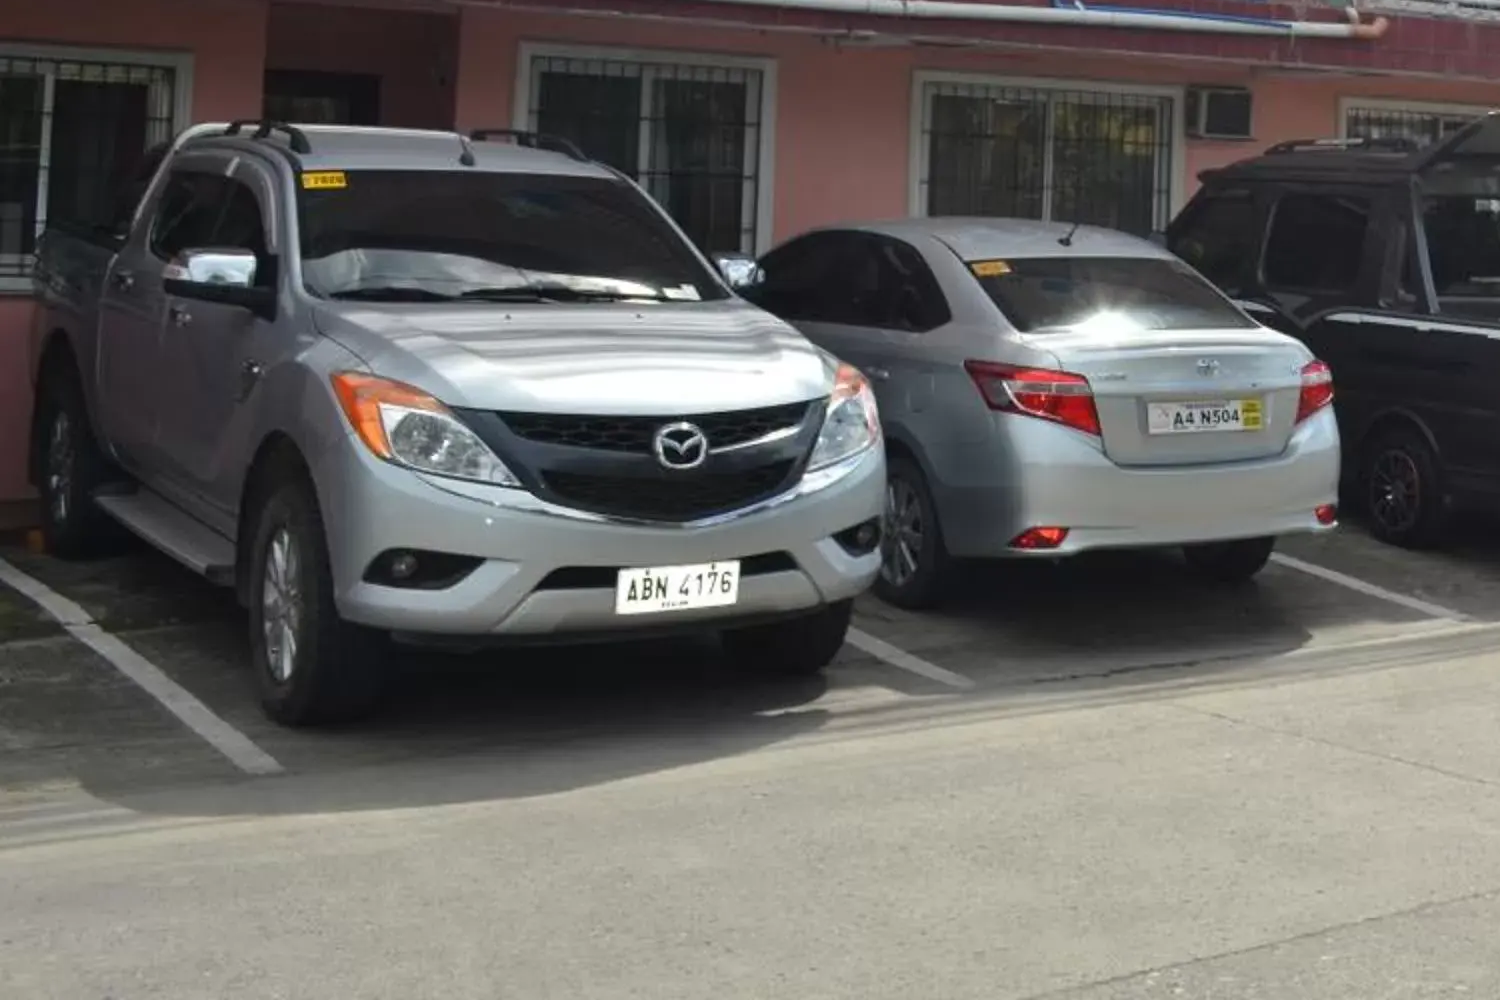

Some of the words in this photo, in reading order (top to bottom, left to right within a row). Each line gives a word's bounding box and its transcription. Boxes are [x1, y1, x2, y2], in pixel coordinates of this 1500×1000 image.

[1173, 410, 1195, 425] A4
[626, 576, 669, 602] ABN
[679, 571, 733, 597] 4176
